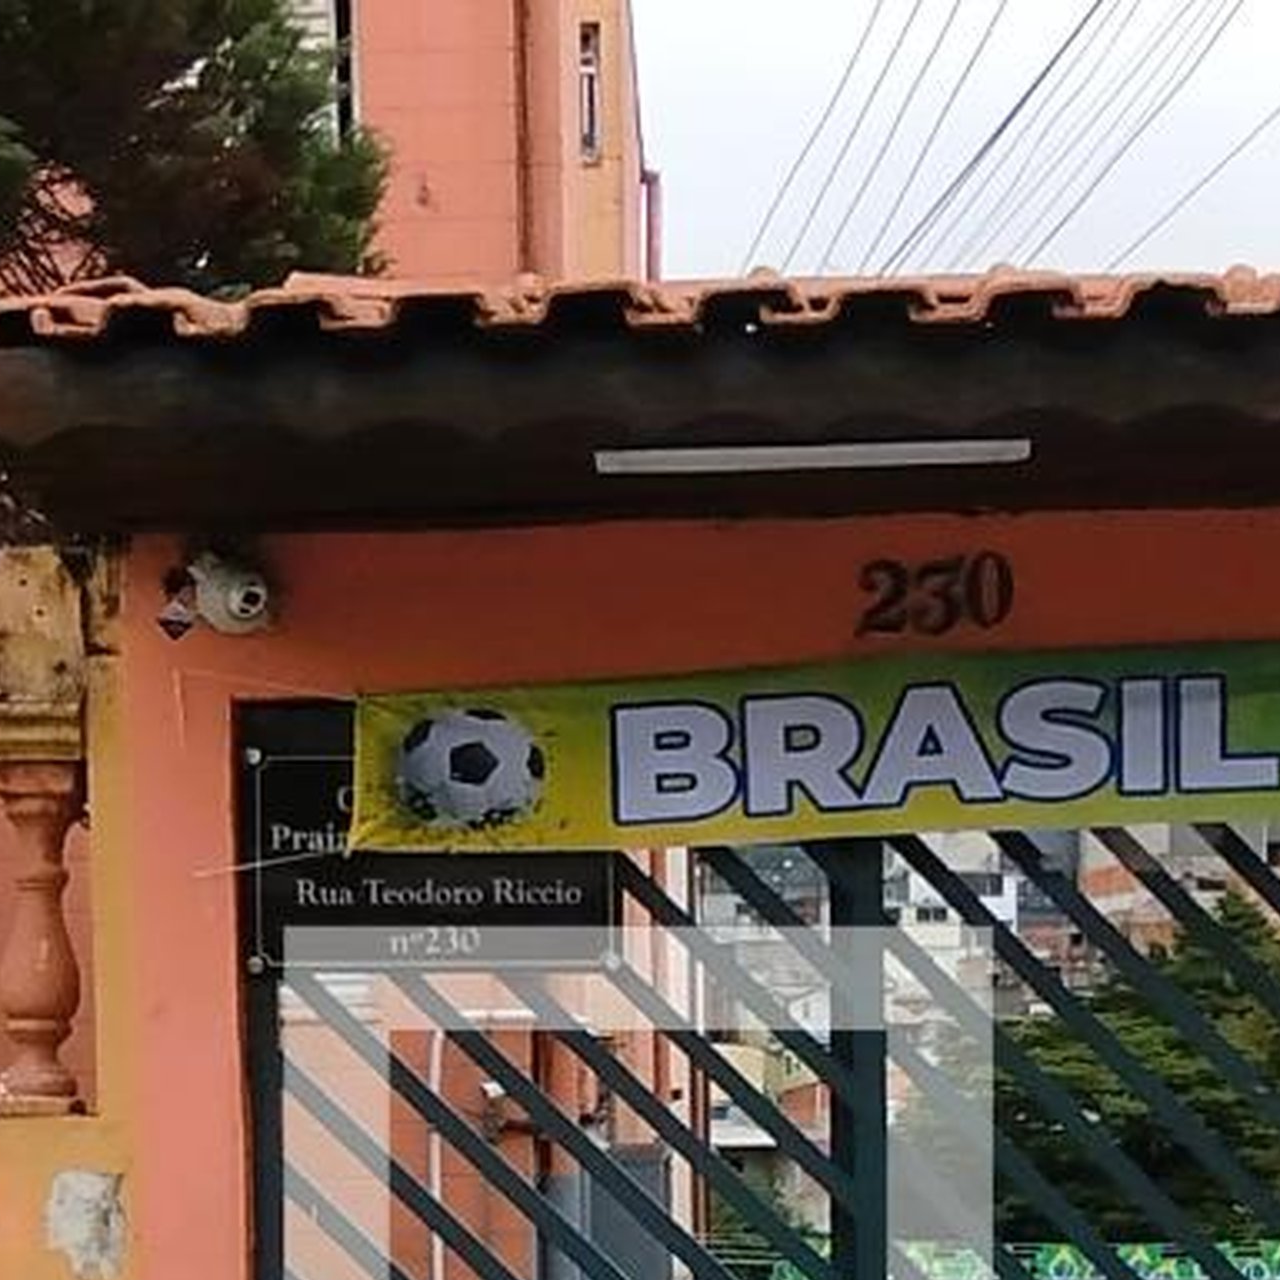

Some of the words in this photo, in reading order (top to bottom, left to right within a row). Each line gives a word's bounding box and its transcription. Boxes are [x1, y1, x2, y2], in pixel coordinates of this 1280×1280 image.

[853, 550, 1016, 638] 230
[296, 877, 355, 906] Rua
[362, 877, 484, 906] Teodoro
[493, 877, 583, 906] Riccio
